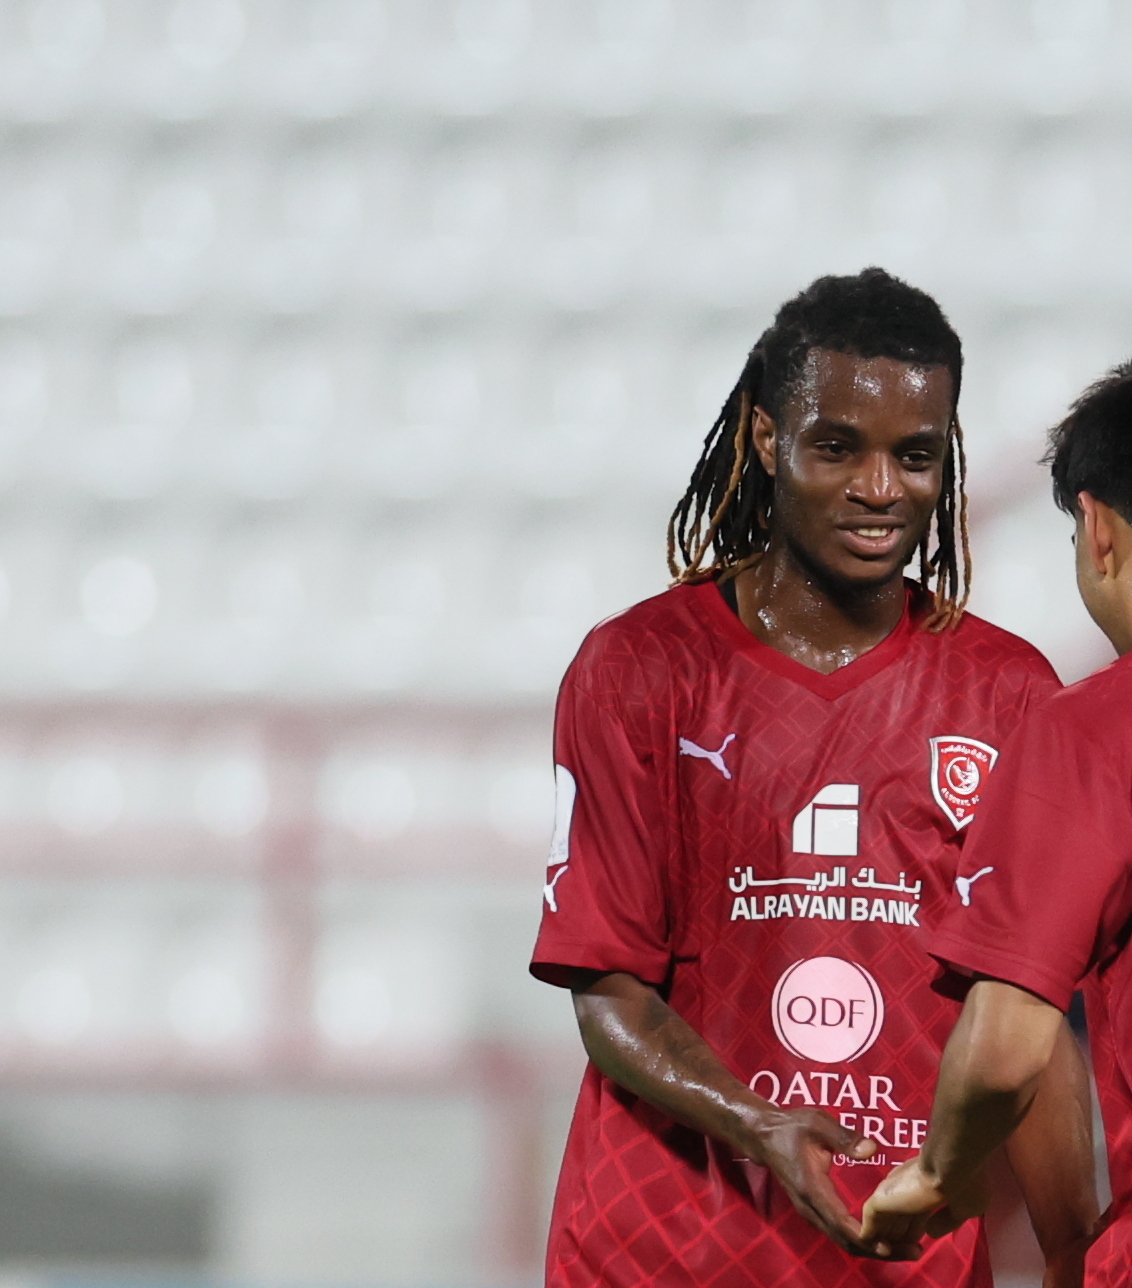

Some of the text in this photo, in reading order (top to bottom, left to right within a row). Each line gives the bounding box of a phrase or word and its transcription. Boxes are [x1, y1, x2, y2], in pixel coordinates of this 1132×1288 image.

[730, 893, 920, 927] ALRAYAN BANK
[786, 995, 866, 1029] QDF
[749, 1070, 902, 1112] QATAR
